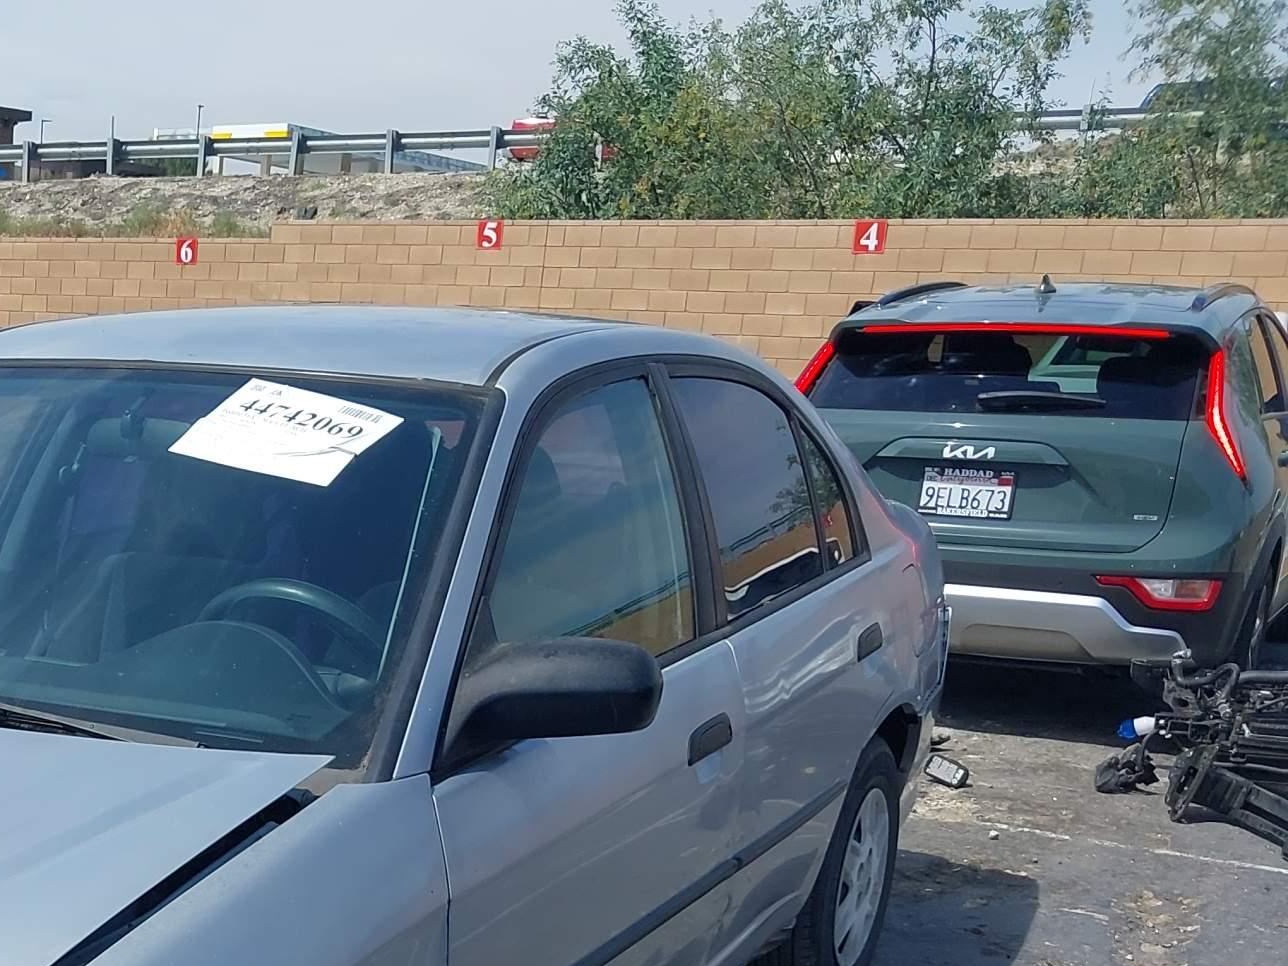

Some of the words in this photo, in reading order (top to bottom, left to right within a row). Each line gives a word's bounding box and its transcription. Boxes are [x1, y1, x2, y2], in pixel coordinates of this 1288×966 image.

[481, 221, 498, 247] 5
[859, 222, 879, 251] 4
[180, 239, 193, 263] 6
[240, 399, 364, 439] 44742069
[943, 467, 994, 478] HADDAD
[923, 486, 1007, 511] 9ELB673
